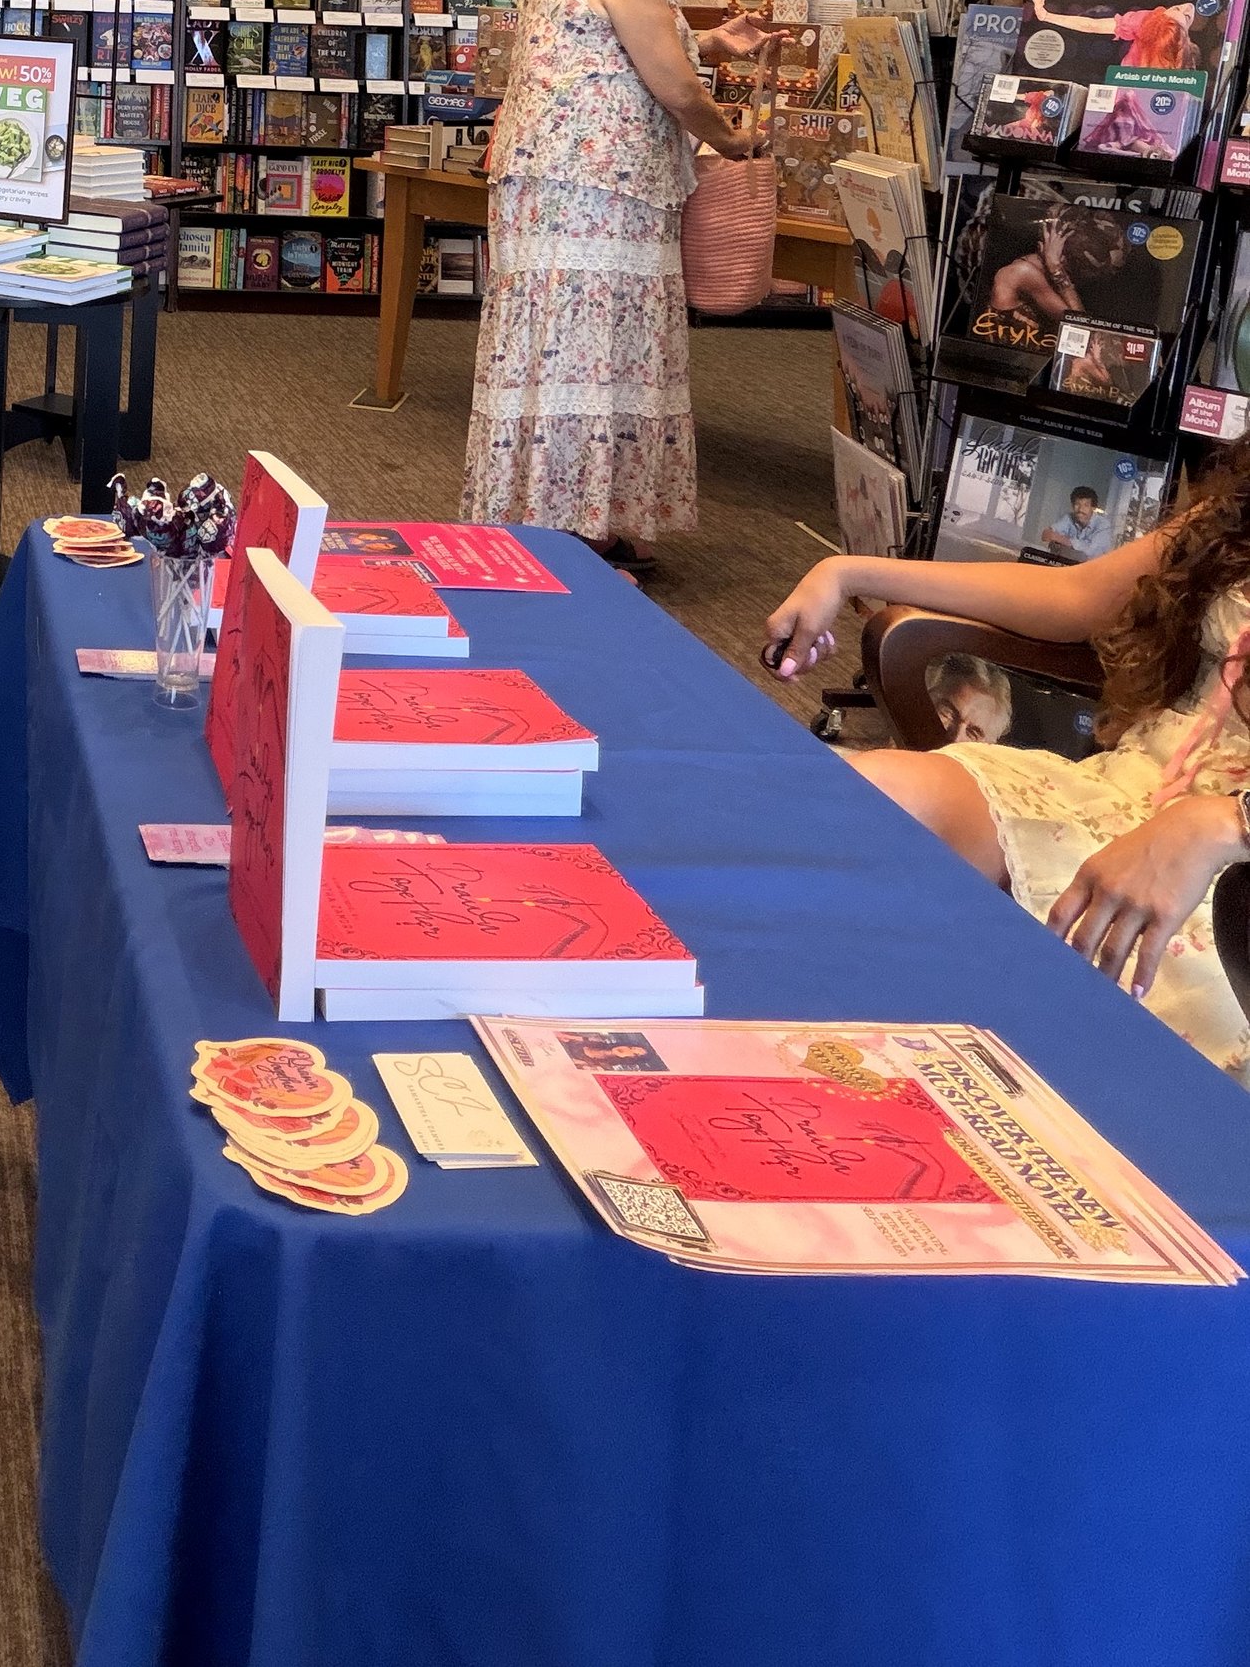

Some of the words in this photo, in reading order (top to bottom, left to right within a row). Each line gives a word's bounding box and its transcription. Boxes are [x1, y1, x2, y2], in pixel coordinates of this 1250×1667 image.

[4, 22, 31, 31] HOCUS
[280, 26, 288, 34] WE
[288, 26, 301, 34] ARE
[317, 28, 348, 38] CHILDREN
[191, 30, 220, 67] X
[317, 49, 329, 57] THE
[275, 52, 291, 61] TODAY
[19, 65, 52, 83] 50%
[1114, 71, 1141, 81] Artist
[1141, 72, 1151, 82] of
[1152, 73, 1168, 82] the
[1168, 75, 1198, 85] Month
[427, 96, 467, 107] GEOMAG
[195, 102, 217, 114] DICE
[800, 114, 835, 129] SHIP
[983, 122, 1054, 144] MADONNA
[312, 159, 328, 167] LAST
[316, 168, 346, 176] BROOKLYN
[27, 189, 49, 199] recipes
[9, 196, 31, 205] craving
[178, 232, 212, 242] chosen
[179, 241, 212, 255] family
[346, 241, 361, 251] Haig
[331, 260, 358, 268] MIDNIGHT
[336, 266, 353, 274] TRAIN
[1064, 314, 1089, 325] CLASSIC
[1090, 318, 1111, 328] ALBUM
[1111, 322, 1121, 330] OF
[1122, 324, 1136, 333] THE
[1137, 327, 1155, 335] WEEK
[1188, 396, 1222, 412] Album
[1199, 408, 1214, 417] the
[1184, 413, 1220, 429] Month
[1023, 552, 1048, 565] CLASSIC
[912, 1061, 1023, 1162] MUST-READ
[1008, 1160, 1088, 1229] NOVEL
[937, 1059, 1035, 1146] DISCOVER
[1024, 1145, 1078, 1186] THE
[1063, 1183, 1129, 1233] NEW
